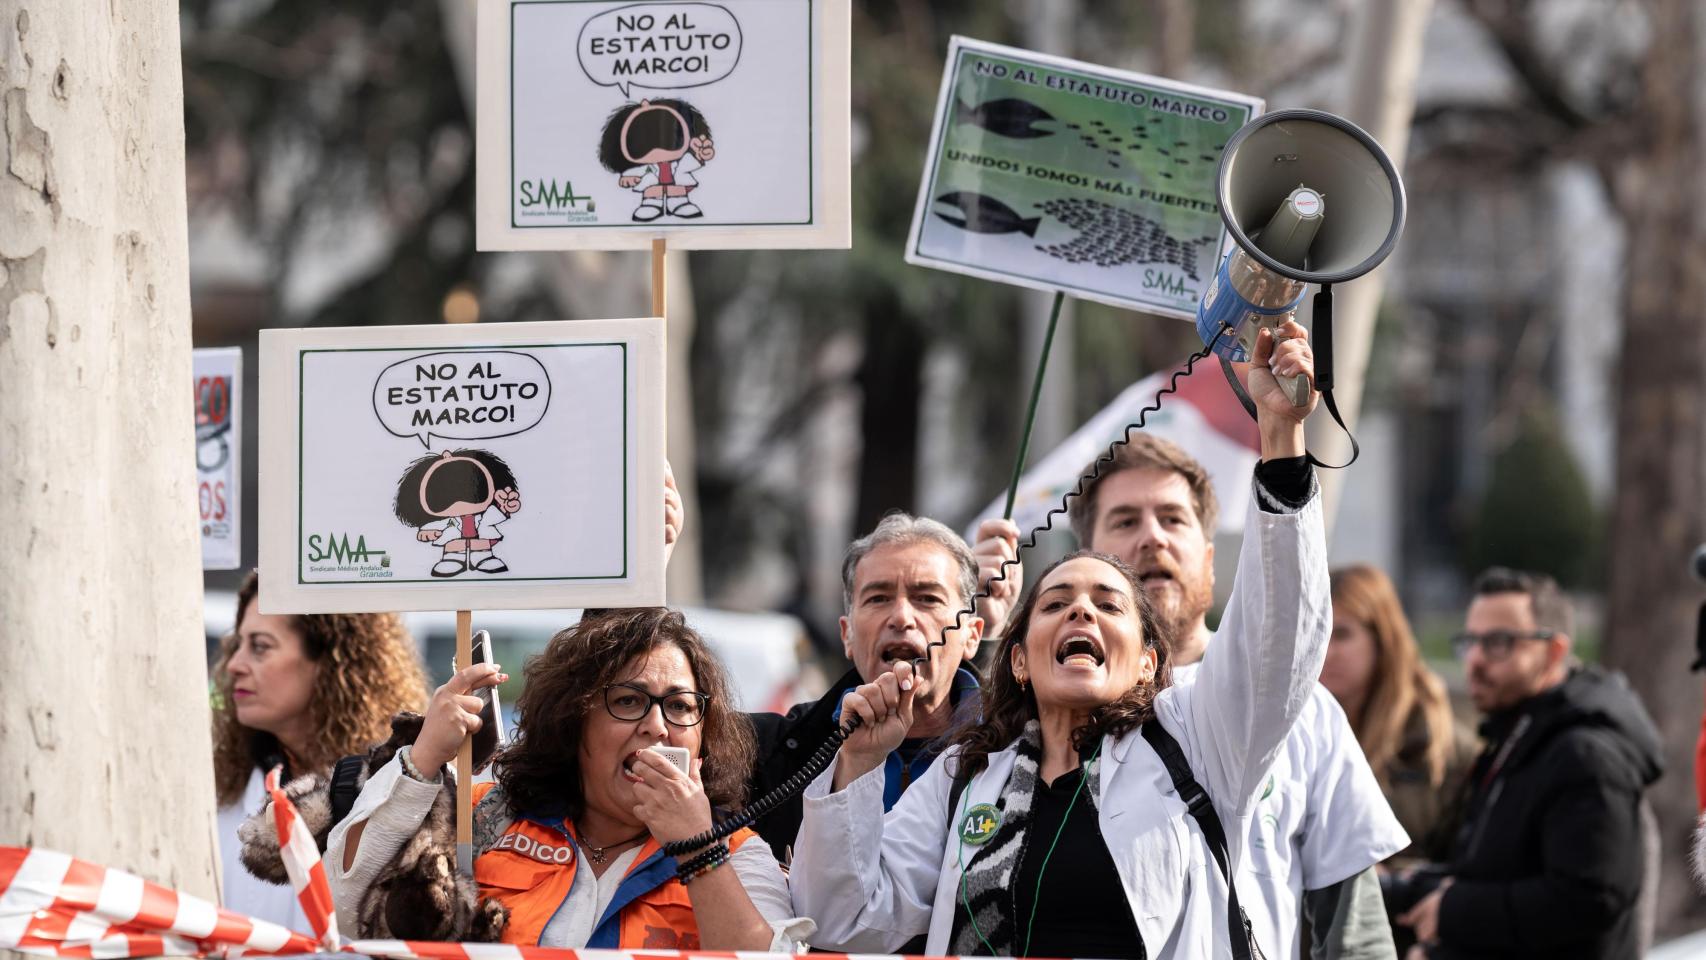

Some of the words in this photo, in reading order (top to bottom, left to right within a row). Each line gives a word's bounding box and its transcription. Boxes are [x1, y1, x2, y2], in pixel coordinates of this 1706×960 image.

[616, 14, 655, 32] NO
[664, 13, 695, 30] AL
[591, 33, 730, 55] ESTATUTO
[612, 55, 708, 76] MARCO!
[976, 61, 1008, 78] NO
[1013, 69, 1039, 85] AL
[1046, 75, 1147, 106] ESTATUTO
[1152, 97, 1229, 123] MARCO
[947, 149, 1019, 173] UNIDOS
[1026, 166, 1089, 187] SOMOS
[1095, 177, 1133, 197] MÁS
[520, 178, 591, 209] SMA
[1142, 268, 1196, 296] SMA
[416, 363, 457, 382] NO
[468, 362, 501, 379] AL
[388, 382, 539, 405] ESTATUTO
[412, 405, 515, 426] MARCO!
[308, 532, 386, 565] SMA
[360, 570, 393, 578] Granada
